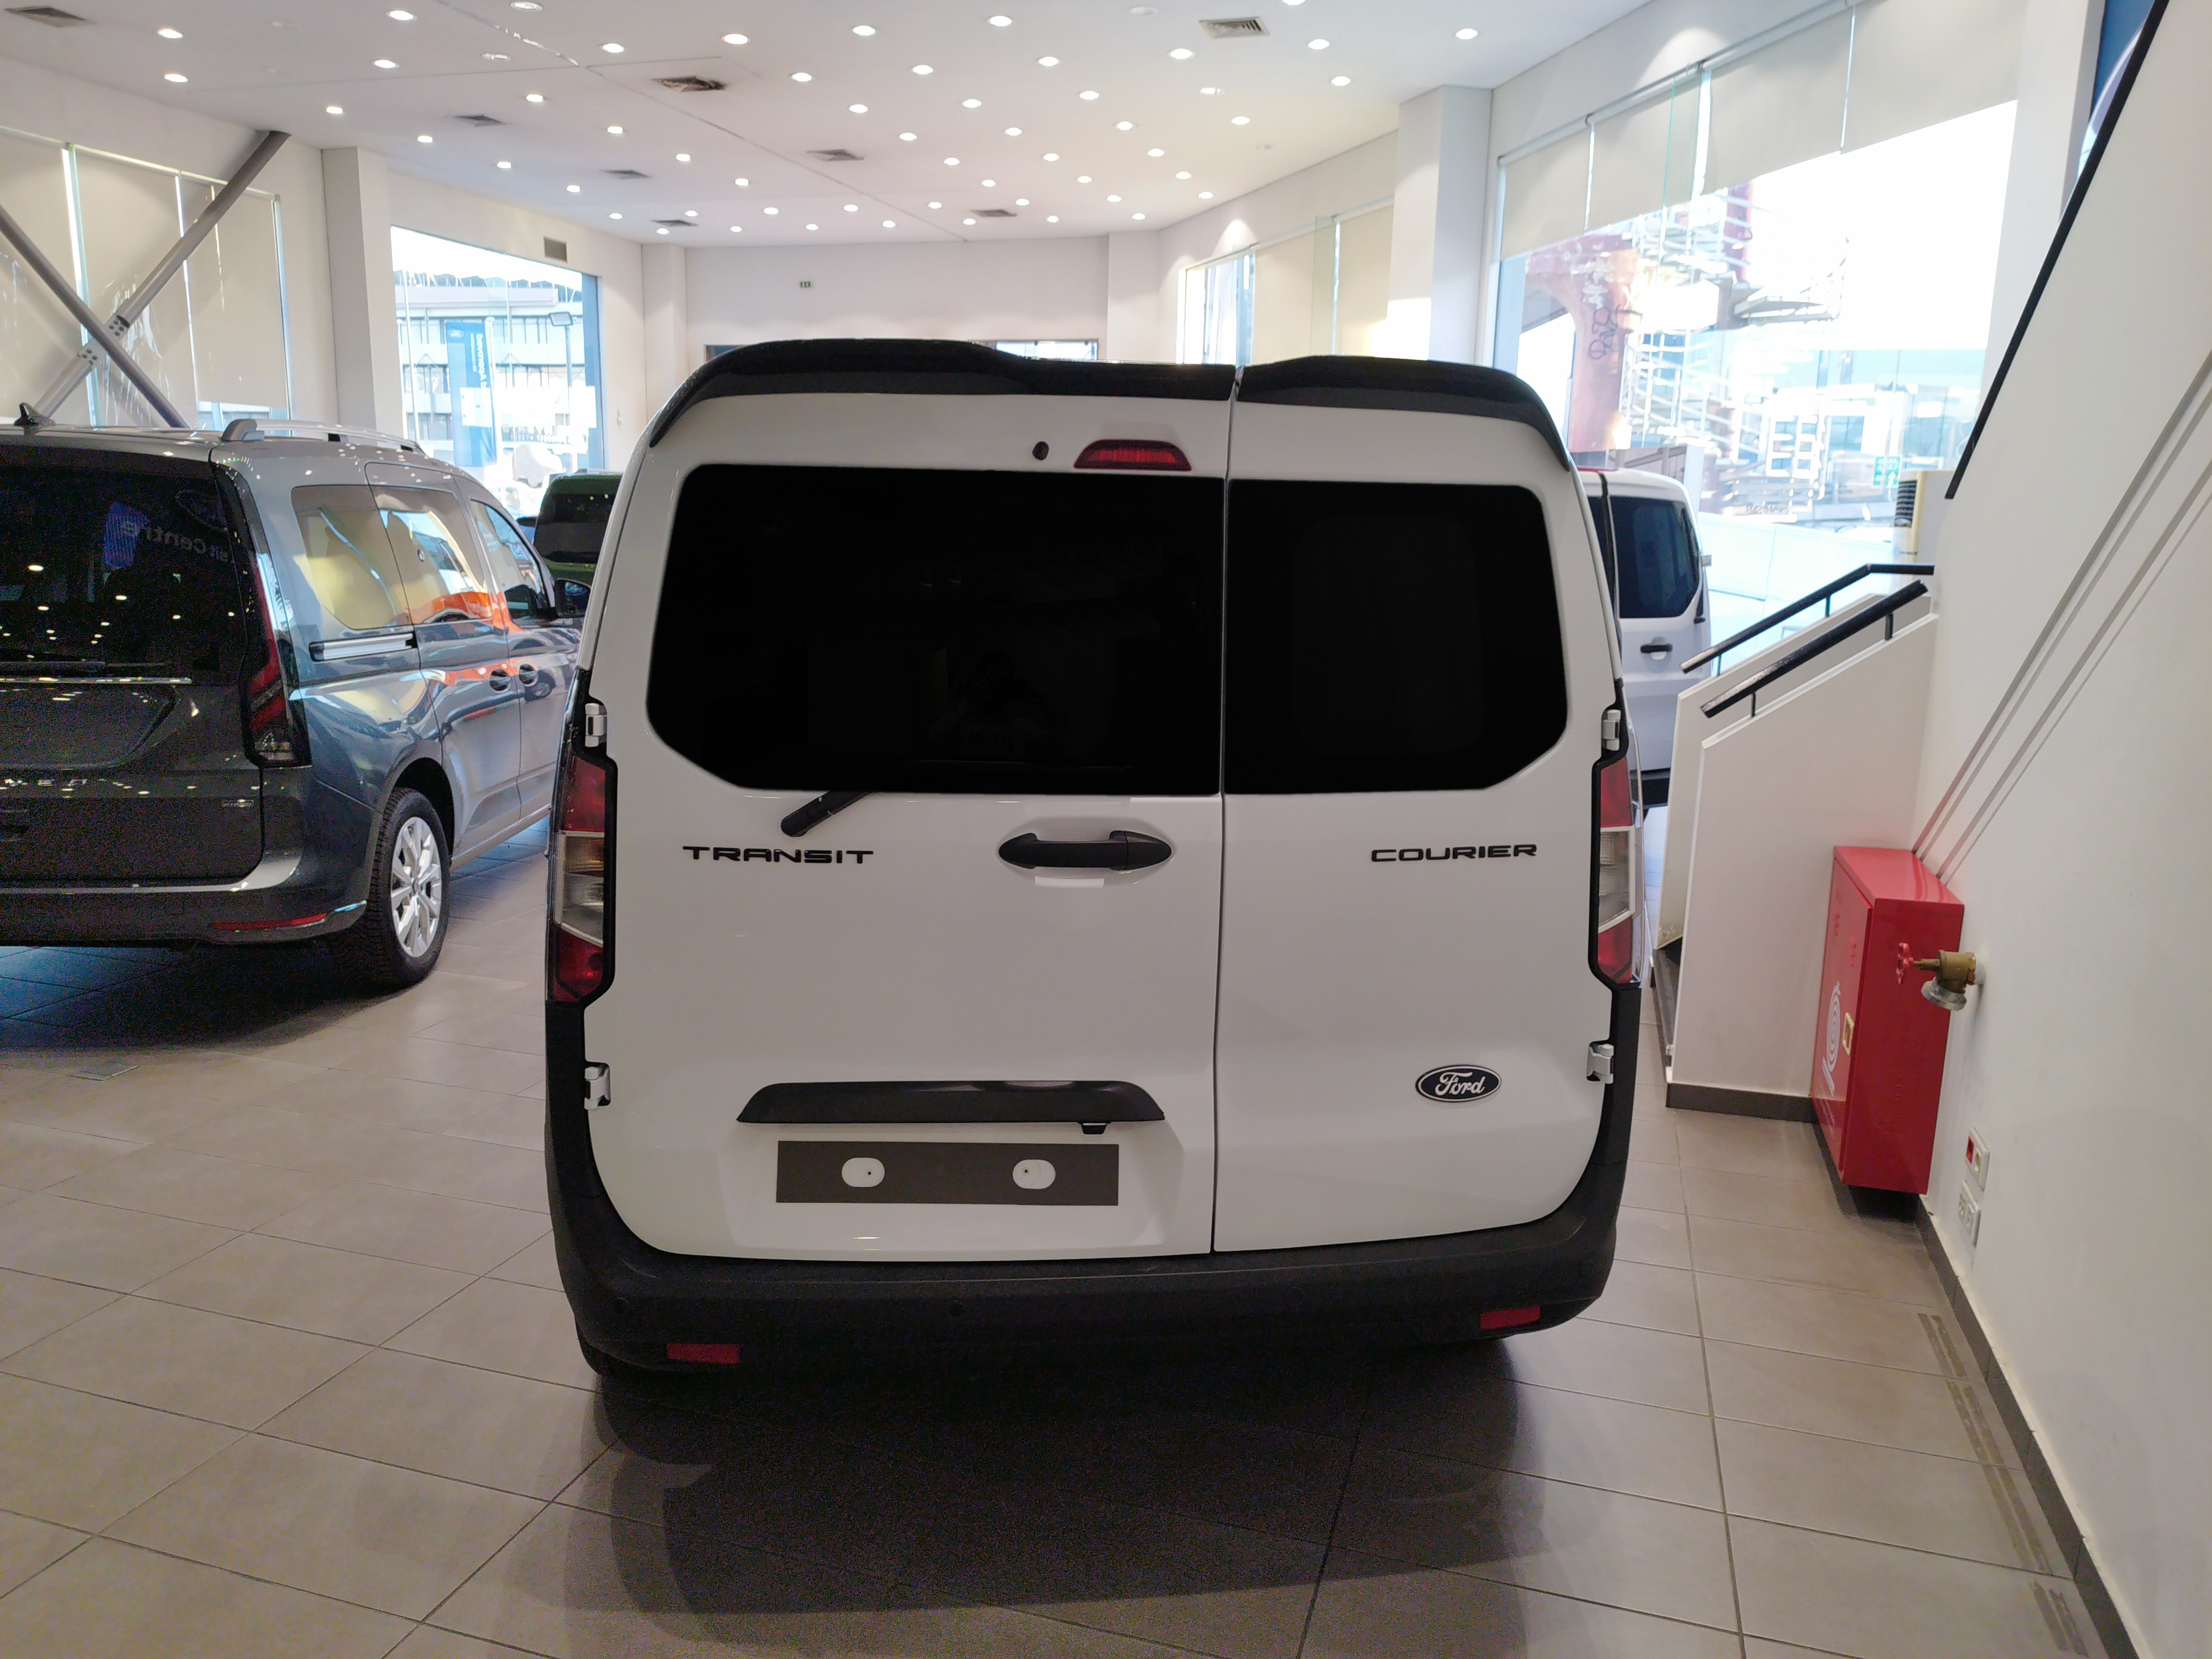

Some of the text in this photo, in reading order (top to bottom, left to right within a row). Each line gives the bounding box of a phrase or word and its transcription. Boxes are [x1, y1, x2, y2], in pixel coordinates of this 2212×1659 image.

[682, 846, 874, 864] TRANSIT
[1371, 844, 1537, 862] COURIER
[1434, 1072, 1486, 1096] Ford
